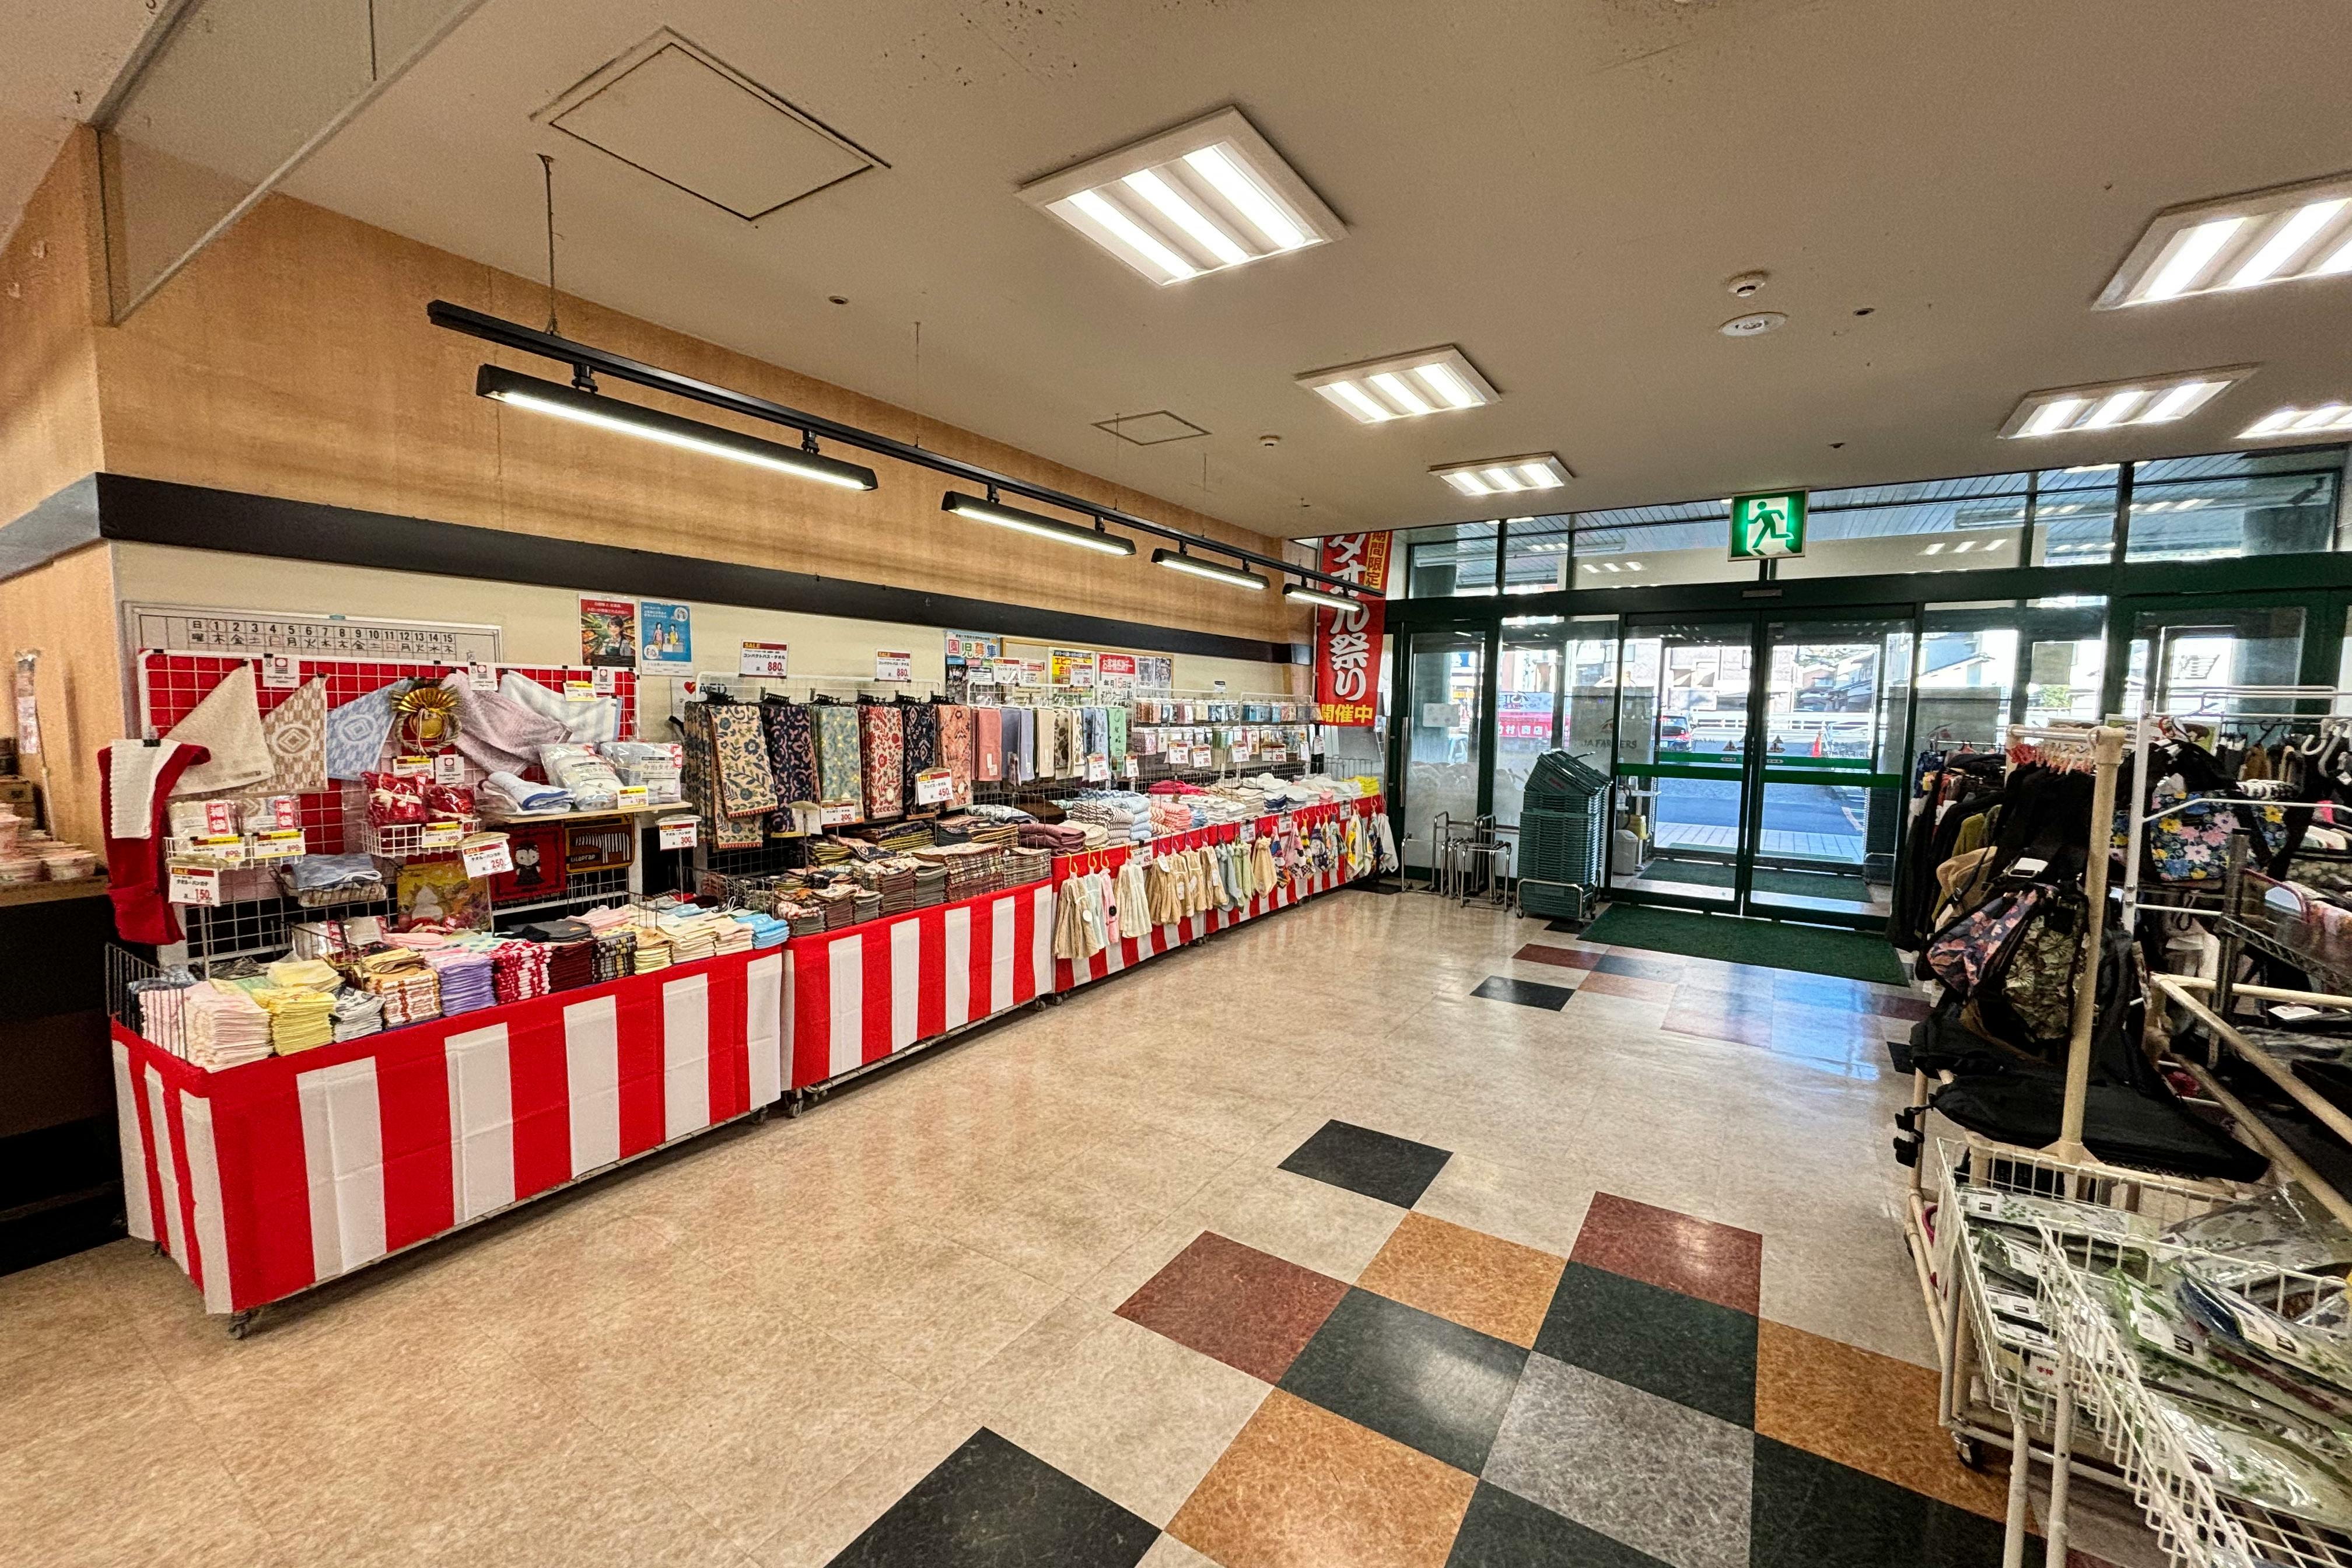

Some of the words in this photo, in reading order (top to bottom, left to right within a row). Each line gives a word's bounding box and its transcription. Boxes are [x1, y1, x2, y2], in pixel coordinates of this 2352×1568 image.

[214, 621, 219, 631] 1
[233, 622, 240, 632] 2
[251, 623, 258, 633] 3
[270, 624, 276, 634] 4
[288, 625, 295, 635] 5
[306, 626, 312, 635] 6
[323, 627, 328, 636] 7
[339, 628, 345, 638] 8
[355, 629, 362, 638] 9
[369, 630, 379, 639] 10
[384, 631, 394, 640] 11
[399, 631, 410, 640] 12
[414, 632, 424, 641] 13
[429, 634, 438, 642] 14
[443, 634, 453, 642] 15
[230, 634, 244, 645] 金
[287, 637, 297, 647] 月
[304, 638, 316, 648] 火
[352, 640, 365, 650] 金
[401, 643, 411, 652] 月
[948, 639, 998, 658] 園児募集
[767, 662, 782, 671] 880
[699, 683, 727, 695] AED
[1321, 704, 1373, 724] 開催中
[1581, 739, 1594, 747] JA
[1595, 739, 1637, 749] FARERS
[938, 788, 950, 796] 450
[680, 836, 692, 844] 300
[491, 858, 504, 869] 250
[195, 888, 210, 900] 150
